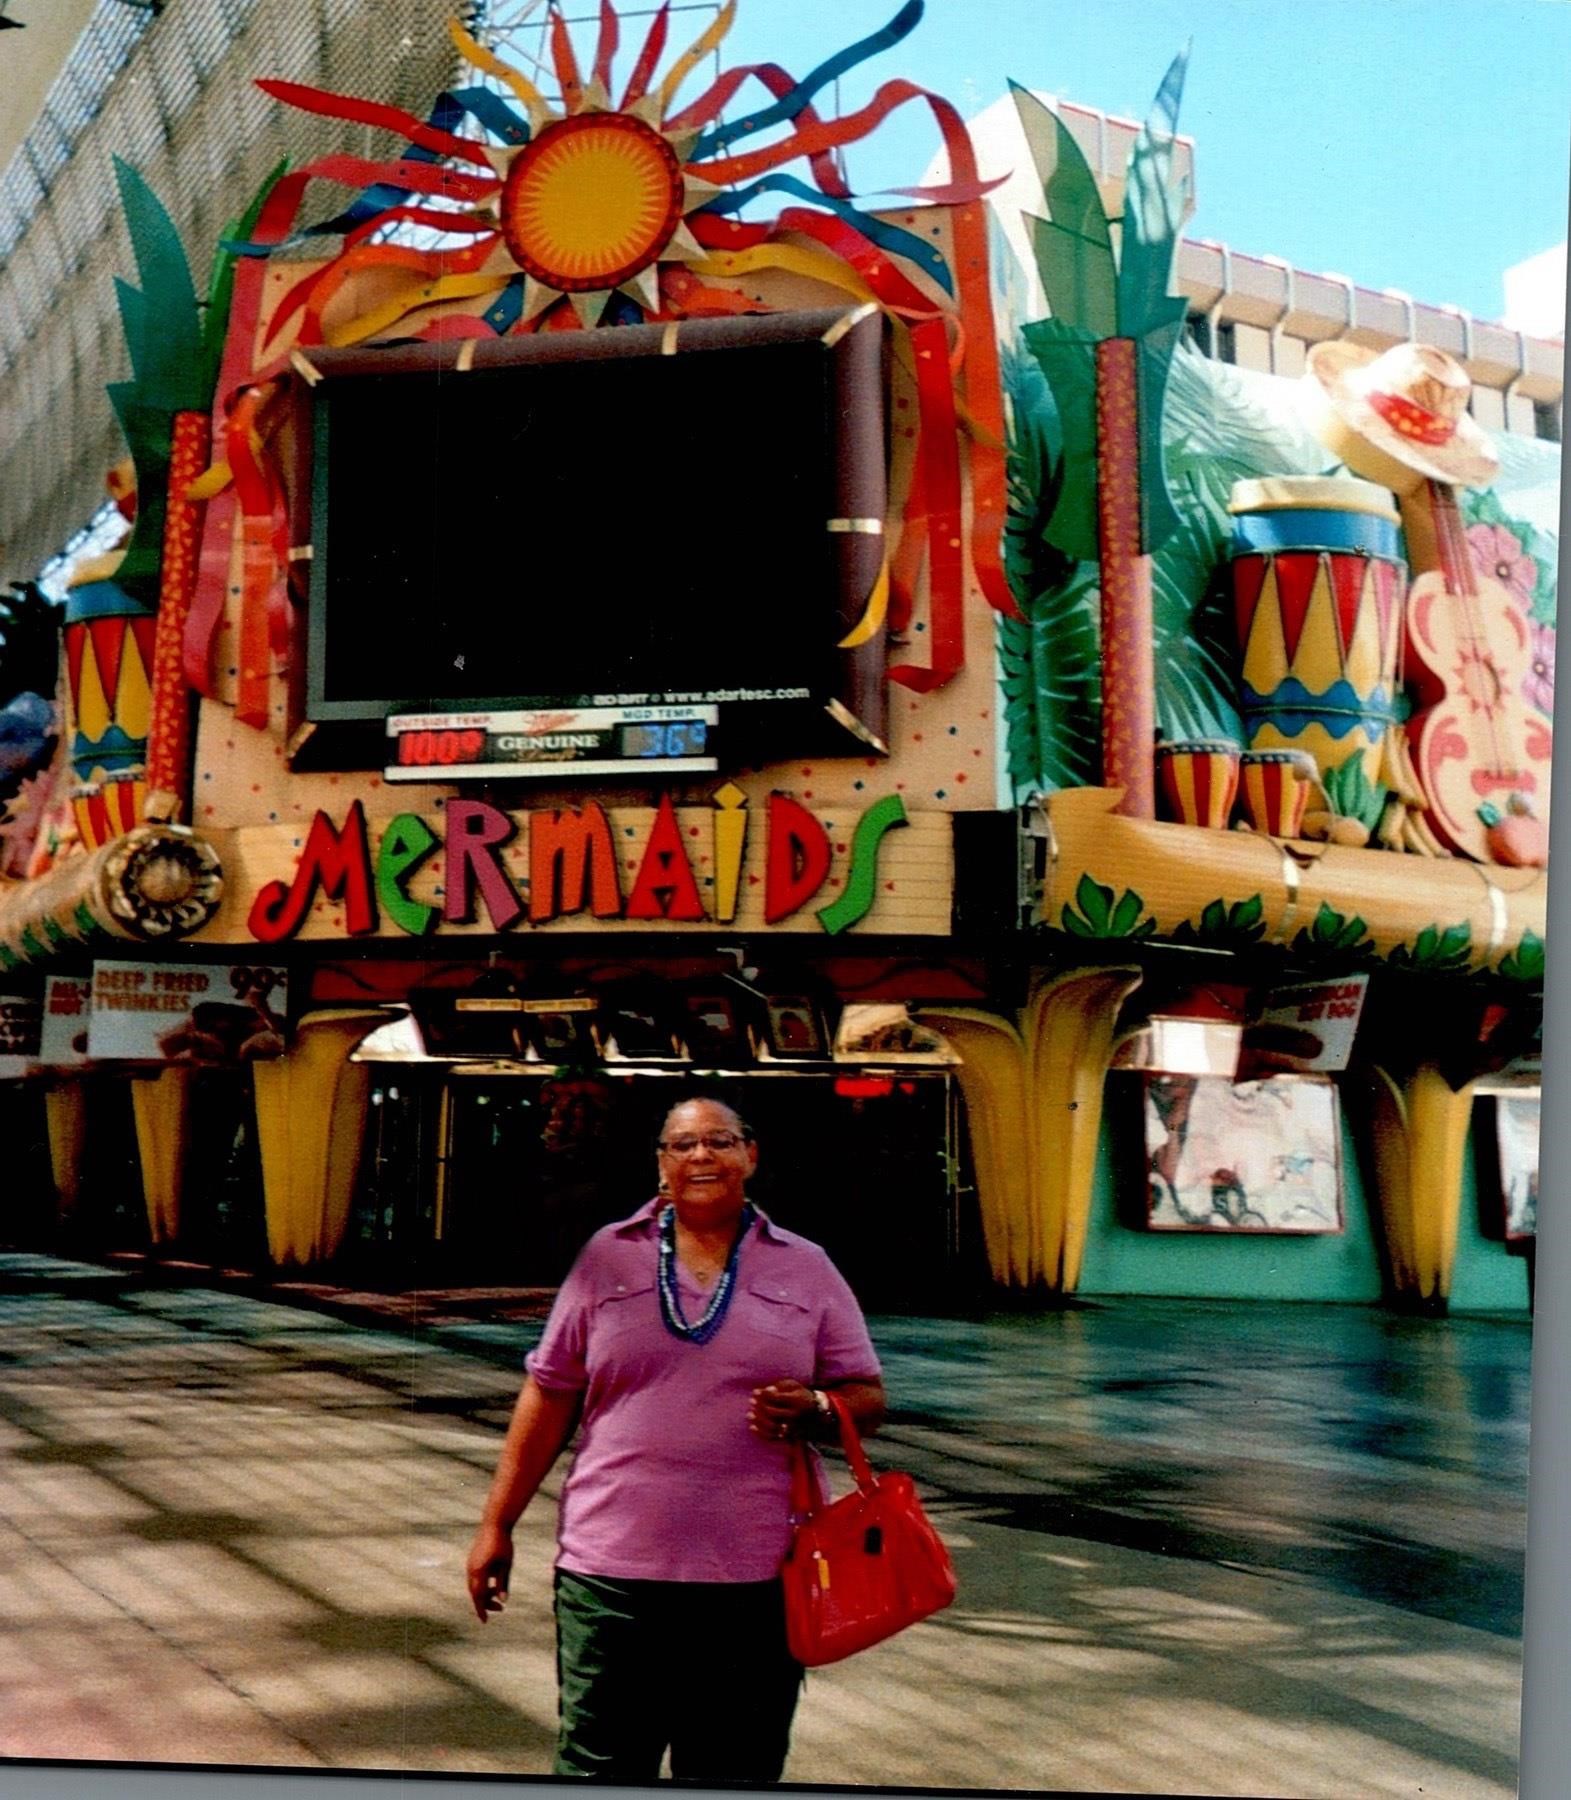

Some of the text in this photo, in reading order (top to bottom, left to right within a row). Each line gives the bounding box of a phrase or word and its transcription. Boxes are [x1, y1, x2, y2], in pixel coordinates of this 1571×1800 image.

[623, 708, 652, 719] MGD
[393, 717, 449, 728] OUTSIDE
[498, 734, 600, 750] GENUINE
[96, 970, 209, 992] DEEP FRIED
[95, 993, 192, 1013] TWINKIES
